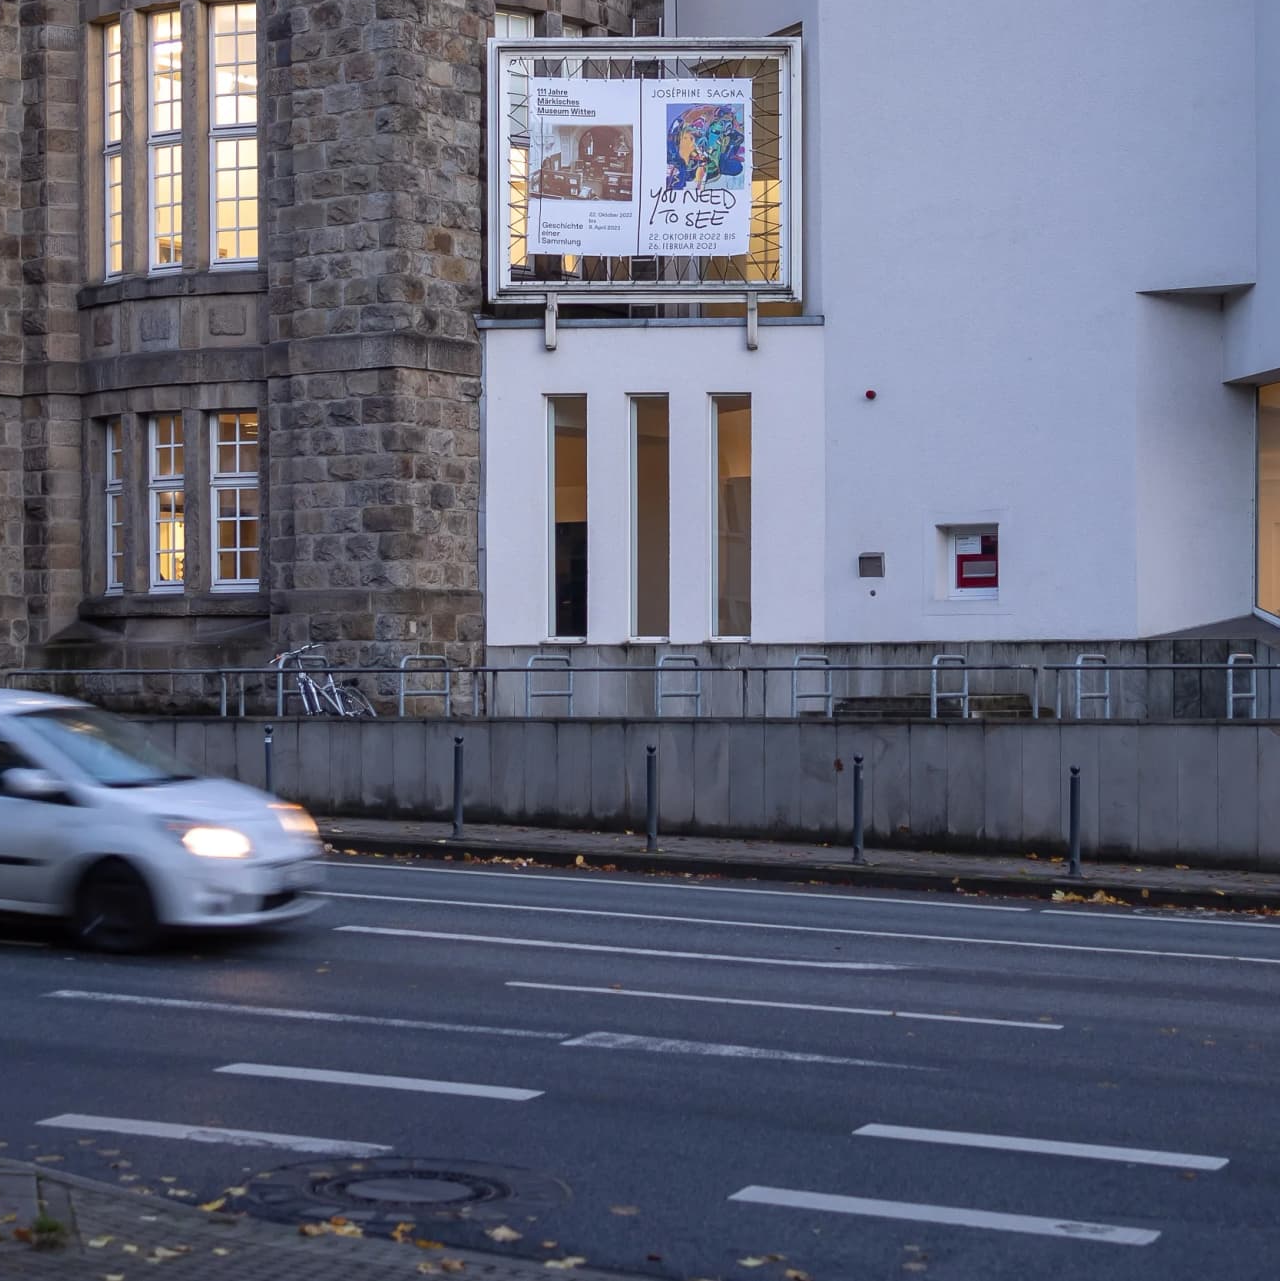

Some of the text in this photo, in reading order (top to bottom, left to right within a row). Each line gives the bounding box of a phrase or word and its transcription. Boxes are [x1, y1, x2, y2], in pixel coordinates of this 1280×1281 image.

[548, 88, 568, 96] Jahre
[651, 87, 744, 98] JOSÉPHINE SAGNA
[537, 97, 580, 106] Märkisches
[537, 107, 596, 116] Museum Witten
[649, 186, 737, 225] YOU NEED
[658, 209, 729, 229] TO SEE
[542, 221, 584, 230] Geschichte
[648, 233, 736, 241] 22. OKTOBER 2022 BIS
[541, 237, 582, 247] Sammlung
[648, 242, 717, 250] 26. FEBRUAR 2023
